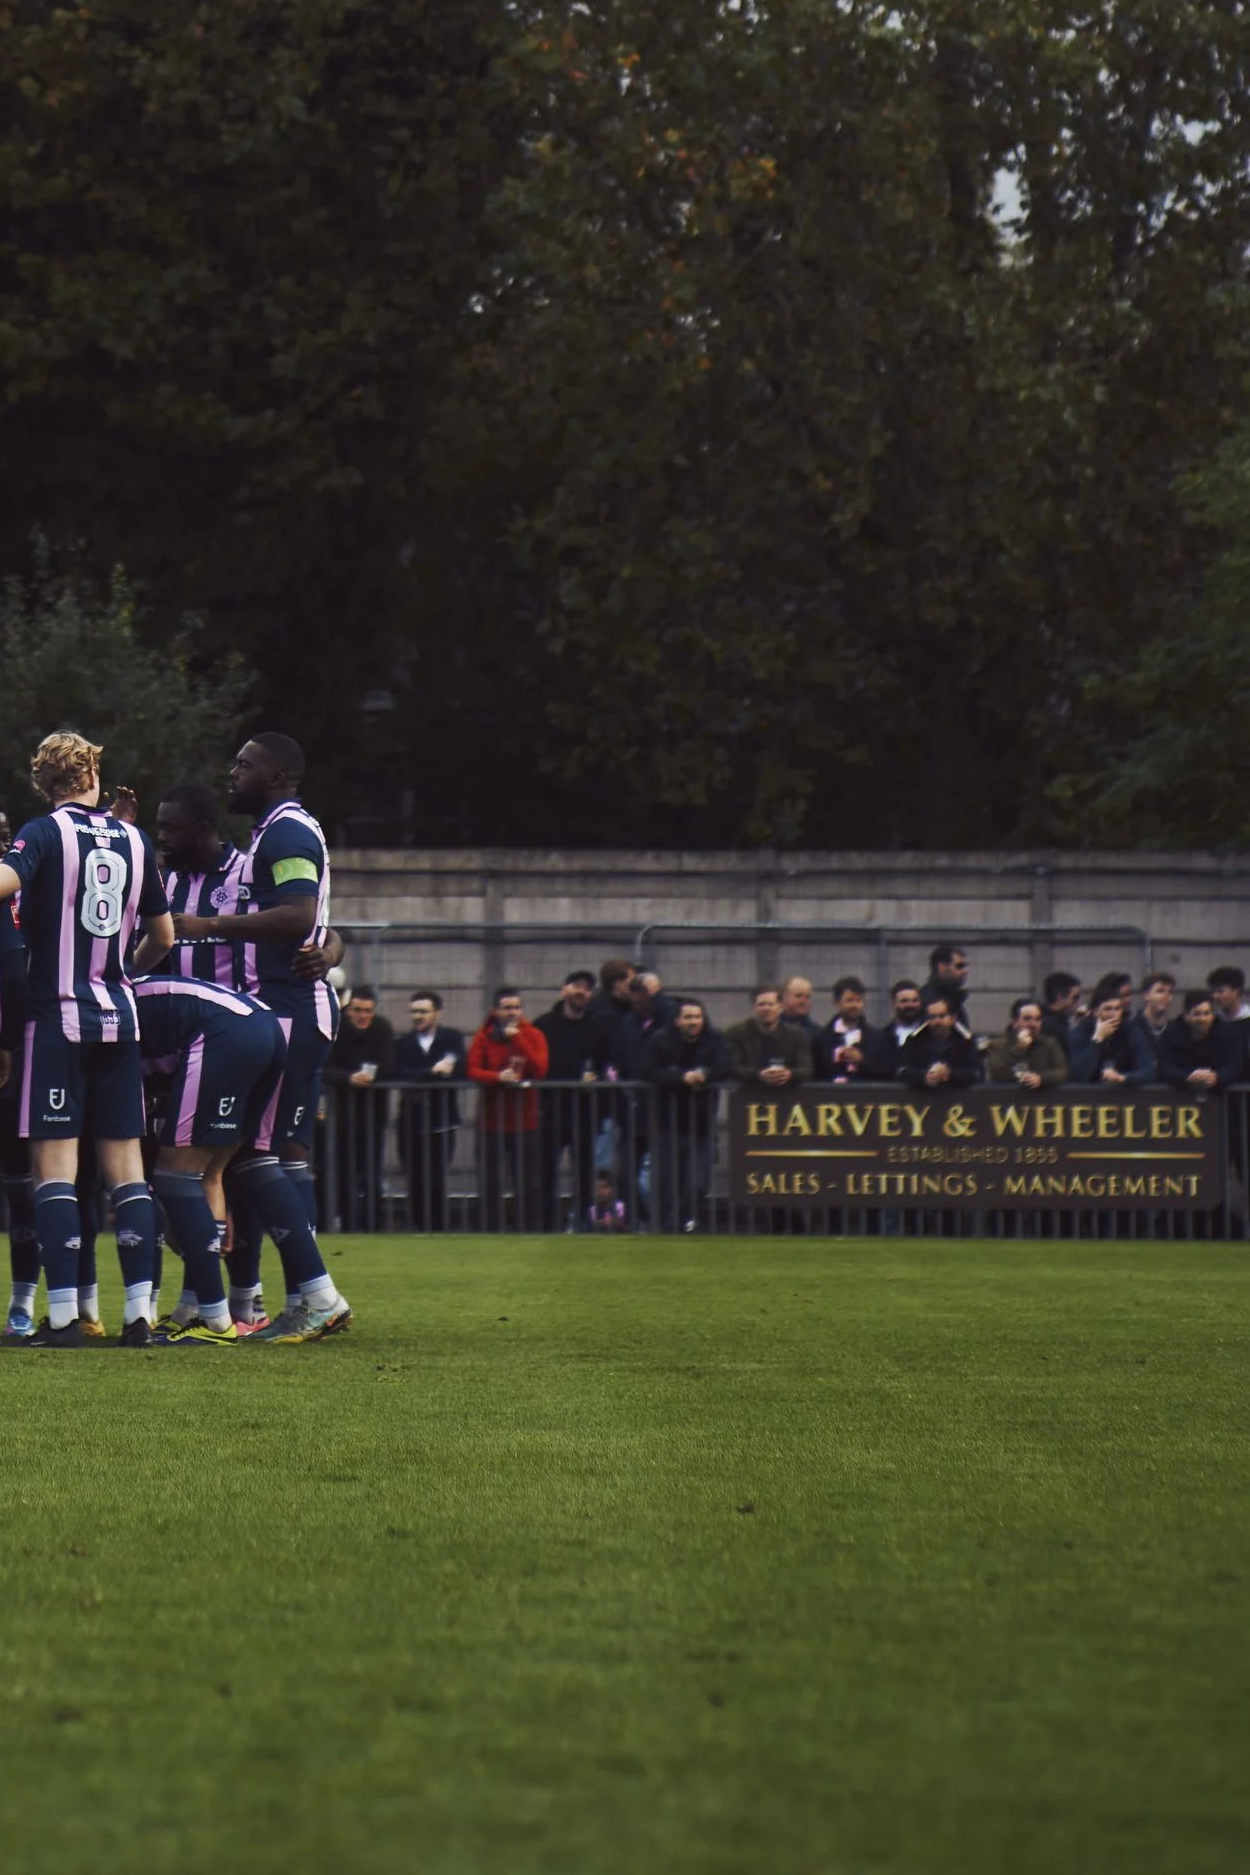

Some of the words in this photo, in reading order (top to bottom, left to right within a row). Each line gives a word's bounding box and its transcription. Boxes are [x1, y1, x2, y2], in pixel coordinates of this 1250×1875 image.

[80, 848, 128, 937] 8
[747, 1103, 930, 1138] HARVEY
[943, 1104, 976, 1138] &
[990, 1104, 1205, 1140] WHEELER
[887, 1145, 1010, 1164] ESTABLISHED
[747, 1172, 820, 1196] SALES
[846, 1172, 979, 1196] LETTINGS
[1002, 1174, 1202, 1197] MANAGEMENT
